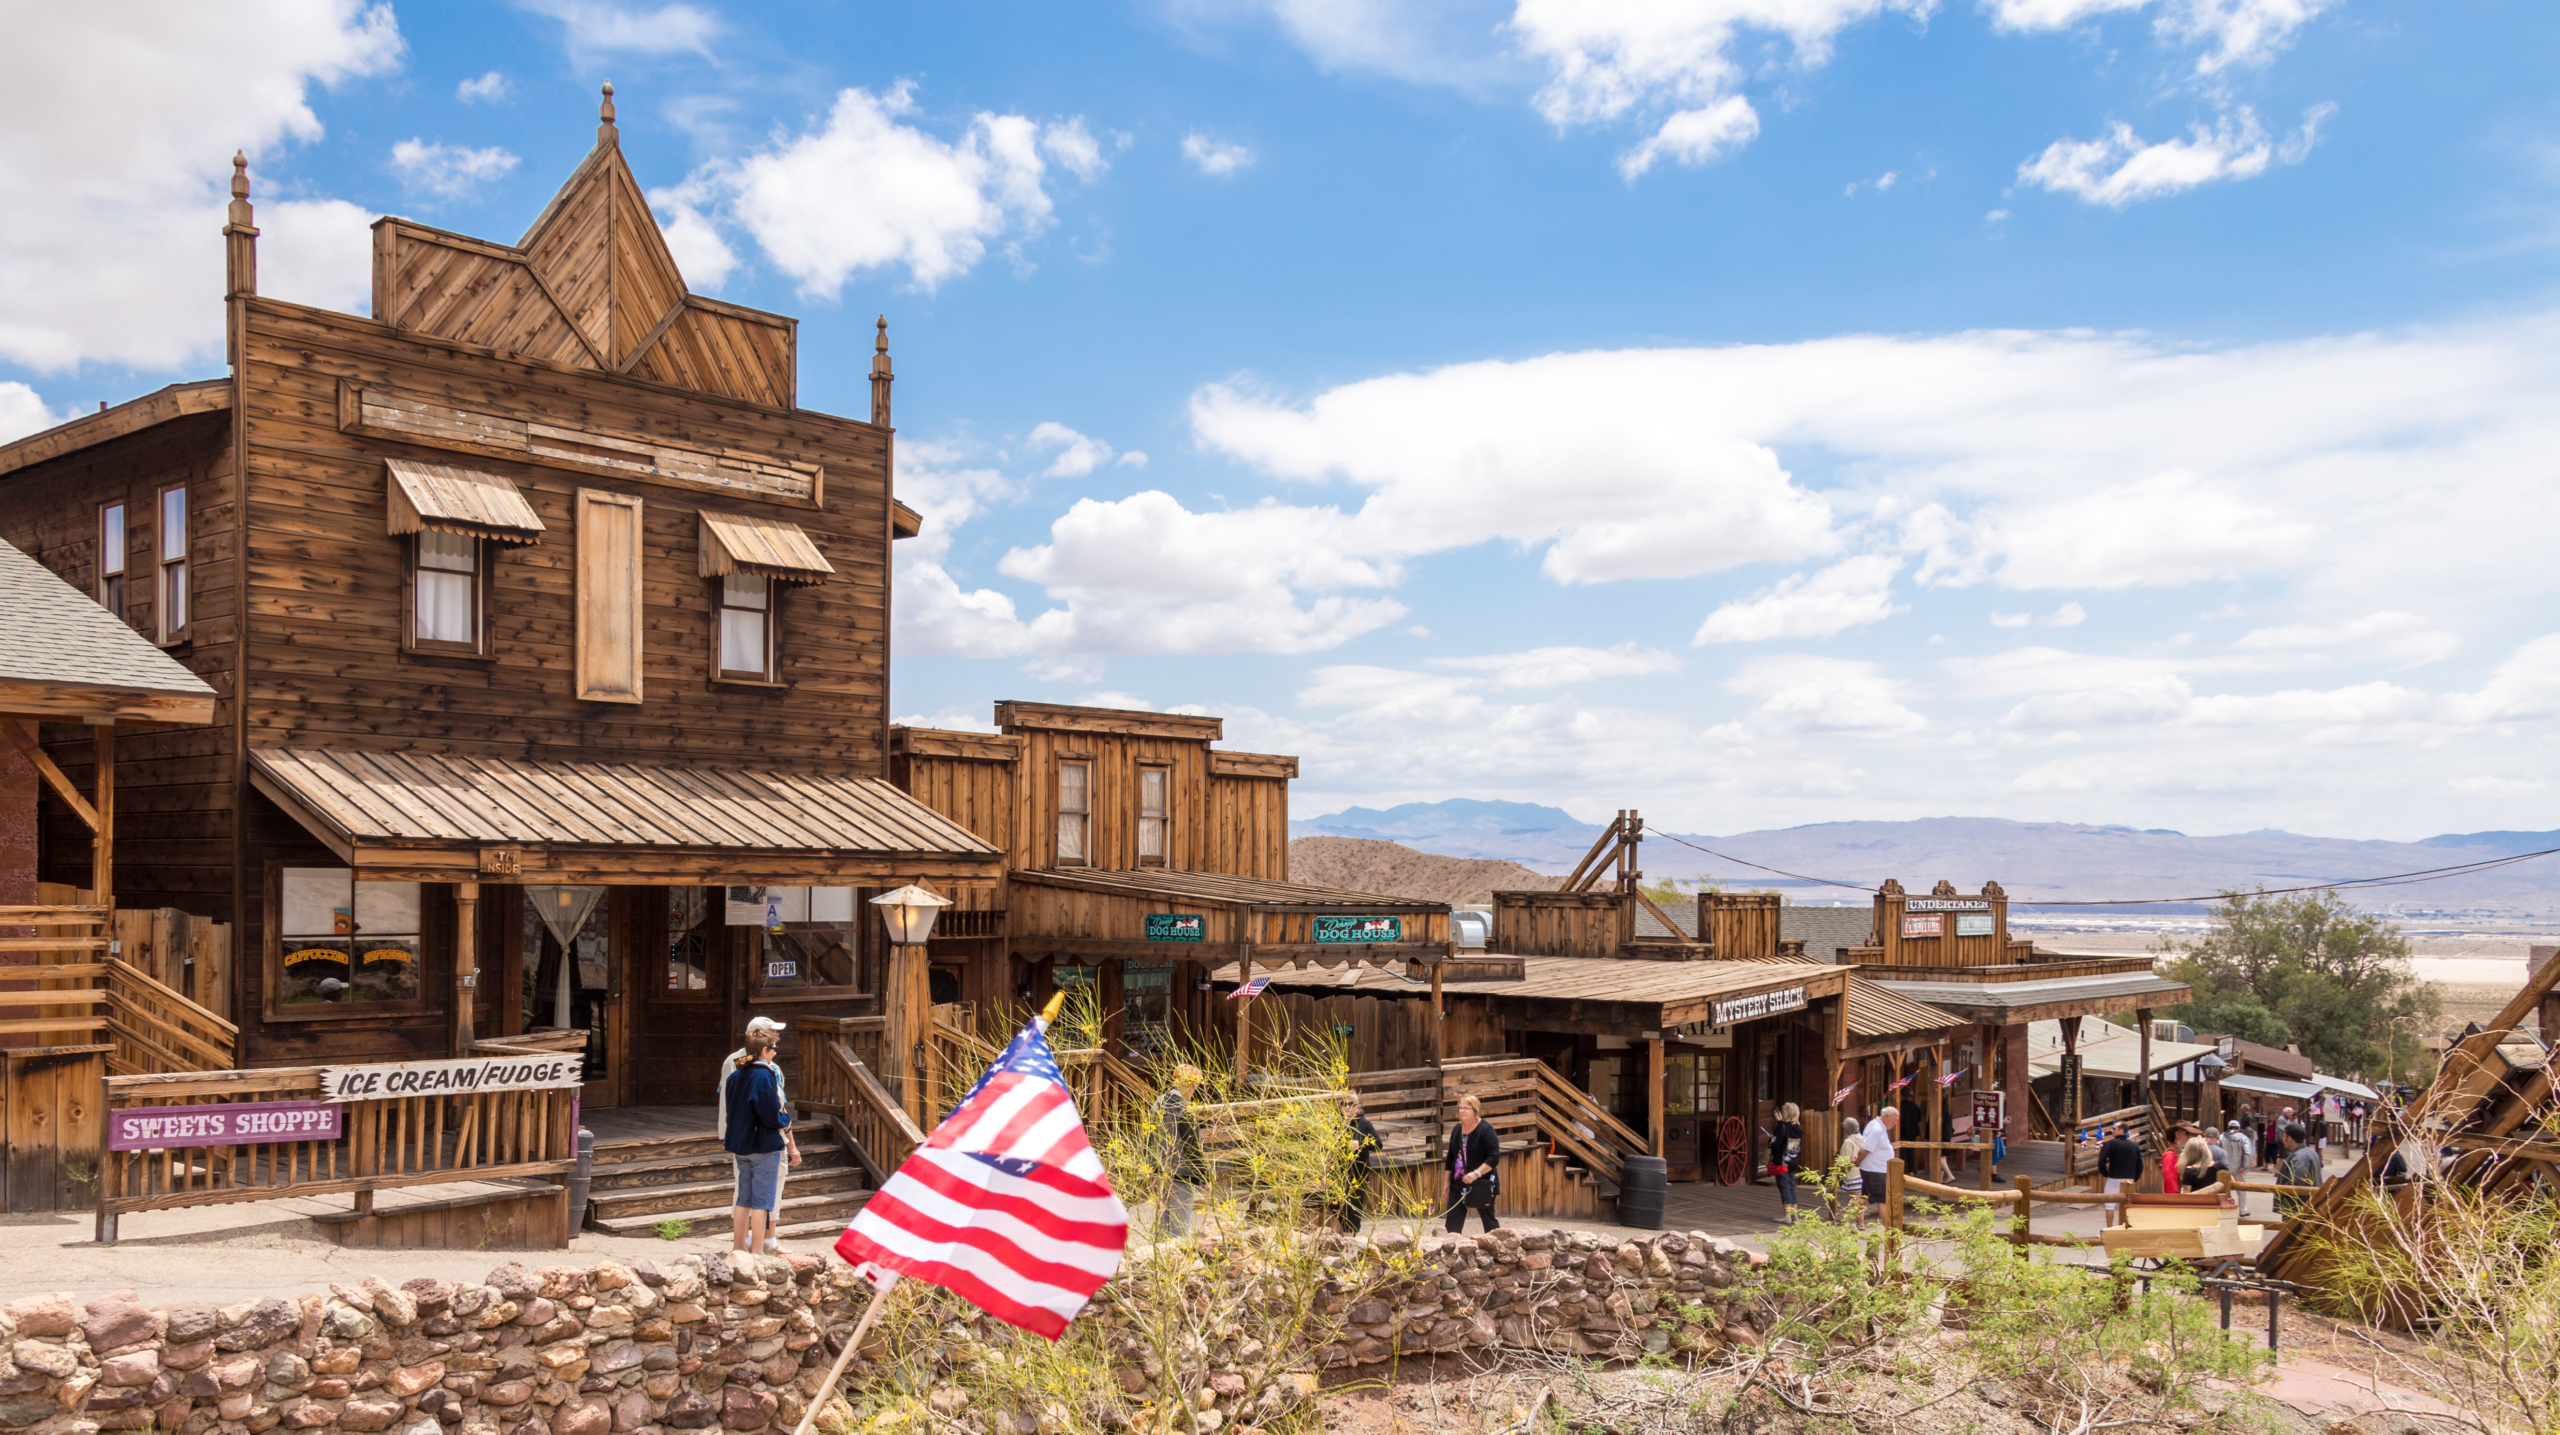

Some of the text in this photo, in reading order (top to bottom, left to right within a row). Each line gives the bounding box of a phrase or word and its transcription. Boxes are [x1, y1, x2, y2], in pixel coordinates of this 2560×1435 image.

[768, 904, 777, 916] A
[1908, 900, 1989, 909] UNDERTAKER
[1149, 926, 1200, 937] DOG HOUSE
[1319, 929, 1396, 939] DOG HOUSE
[285, 949, 349, 966] CAPPUCCINO
[771, 963, 795, 976] OPEN
[1715, 987, 1803, 1023] MYSTERY SHACK
[337, 1060, 564, 1095] ICE CREAM/FUDGE
[122, 1108, 334, 1140] SWEETS SHOPPE
